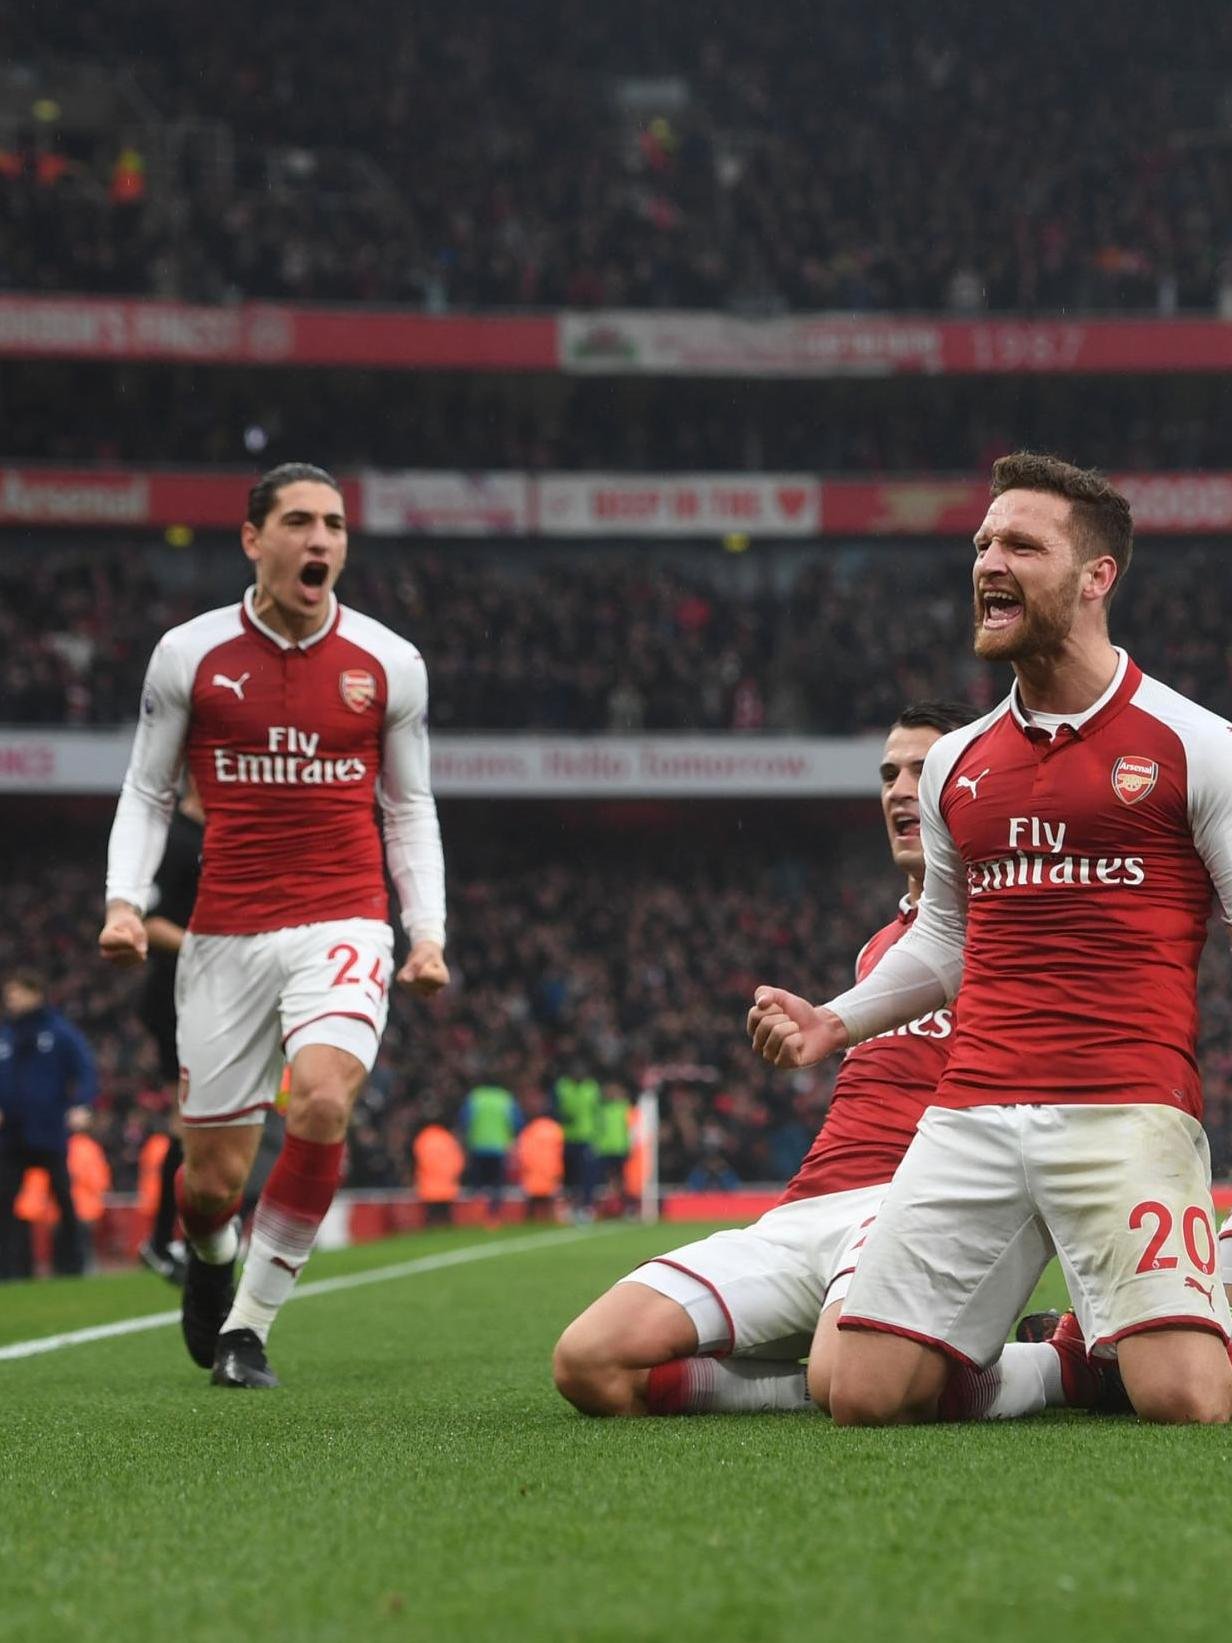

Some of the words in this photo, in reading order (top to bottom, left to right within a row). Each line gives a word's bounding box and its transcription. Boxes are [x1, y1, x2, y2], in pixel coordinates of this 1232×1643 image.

[268, 726, 320, 758] Fly
[214, 749, 367, 784] Emirates
[1120, 762, 1152, 774] Arsenal
[1008, 816, 1066, 853] Fly
[1128, 1200, 1217, 1275] 20
